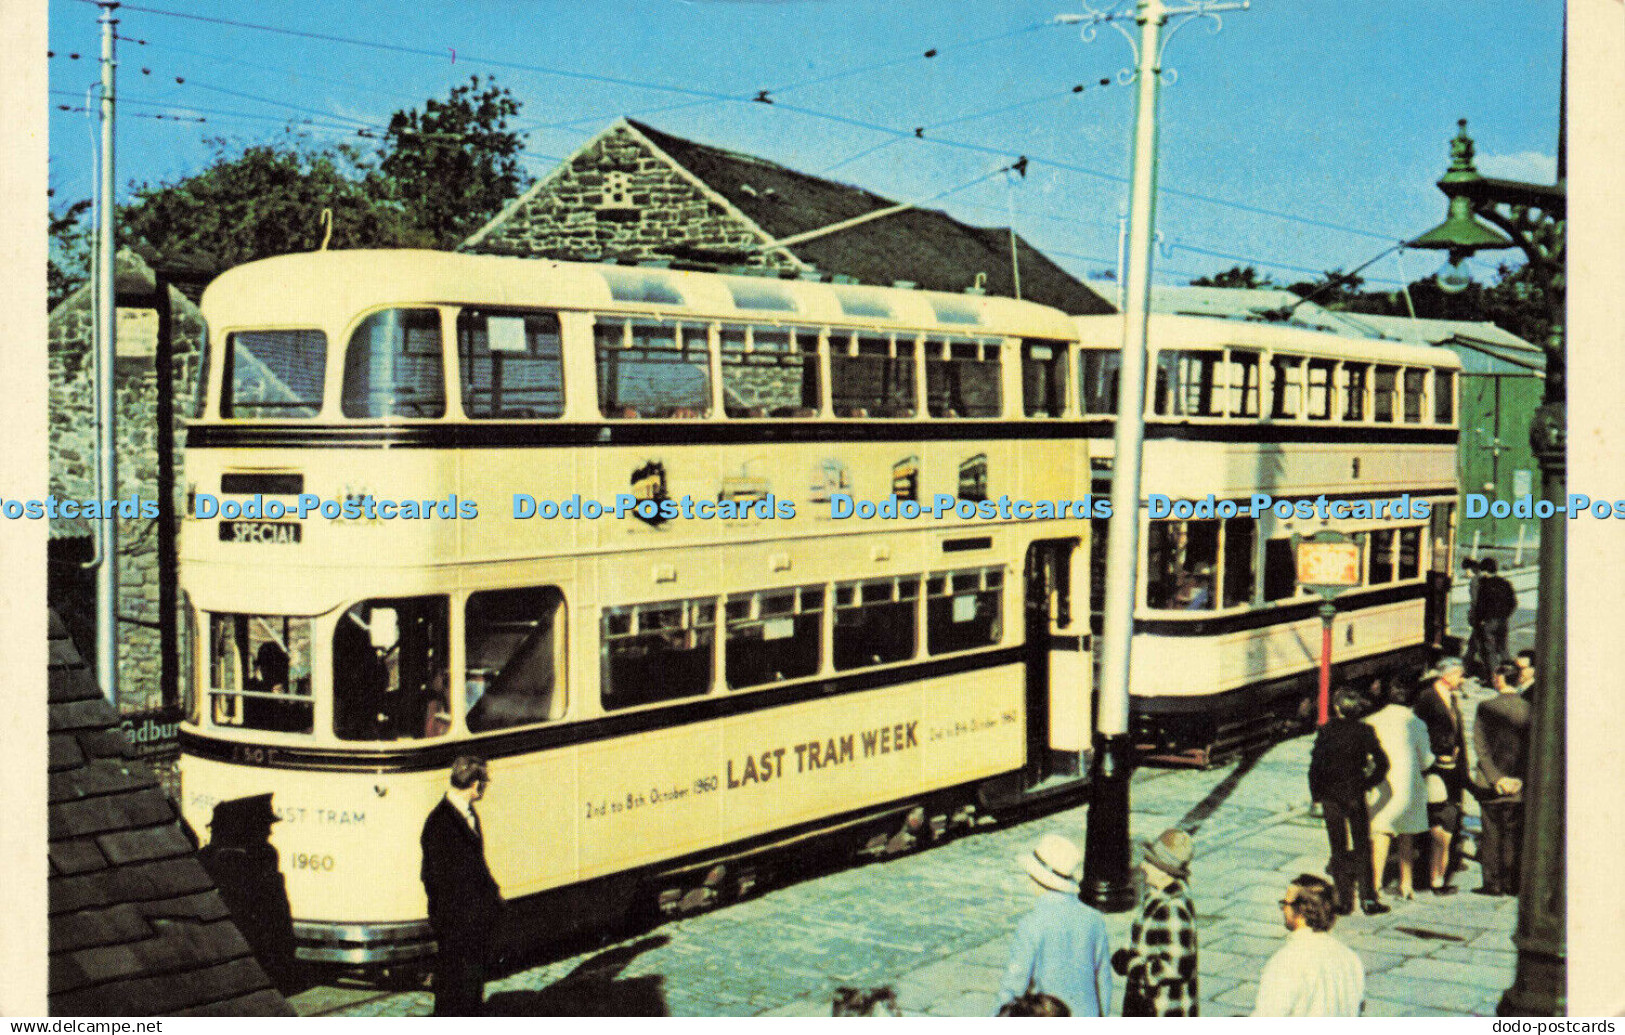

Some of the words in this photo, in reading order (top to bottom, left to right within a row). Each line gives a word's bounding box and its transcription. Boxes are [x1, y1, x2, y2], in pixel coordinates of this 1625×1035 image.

[233, 522, 297, 543] SPECIAL
[727, 747, 786, 790] LAST
[793, 733, 854, 774] TRAM
[861, 720, 919, 760] WEEK
[275, 806, 307, 824] AST
[315, 807, 366, 825] TRAM
[291, 852, 335, 872] 1960
